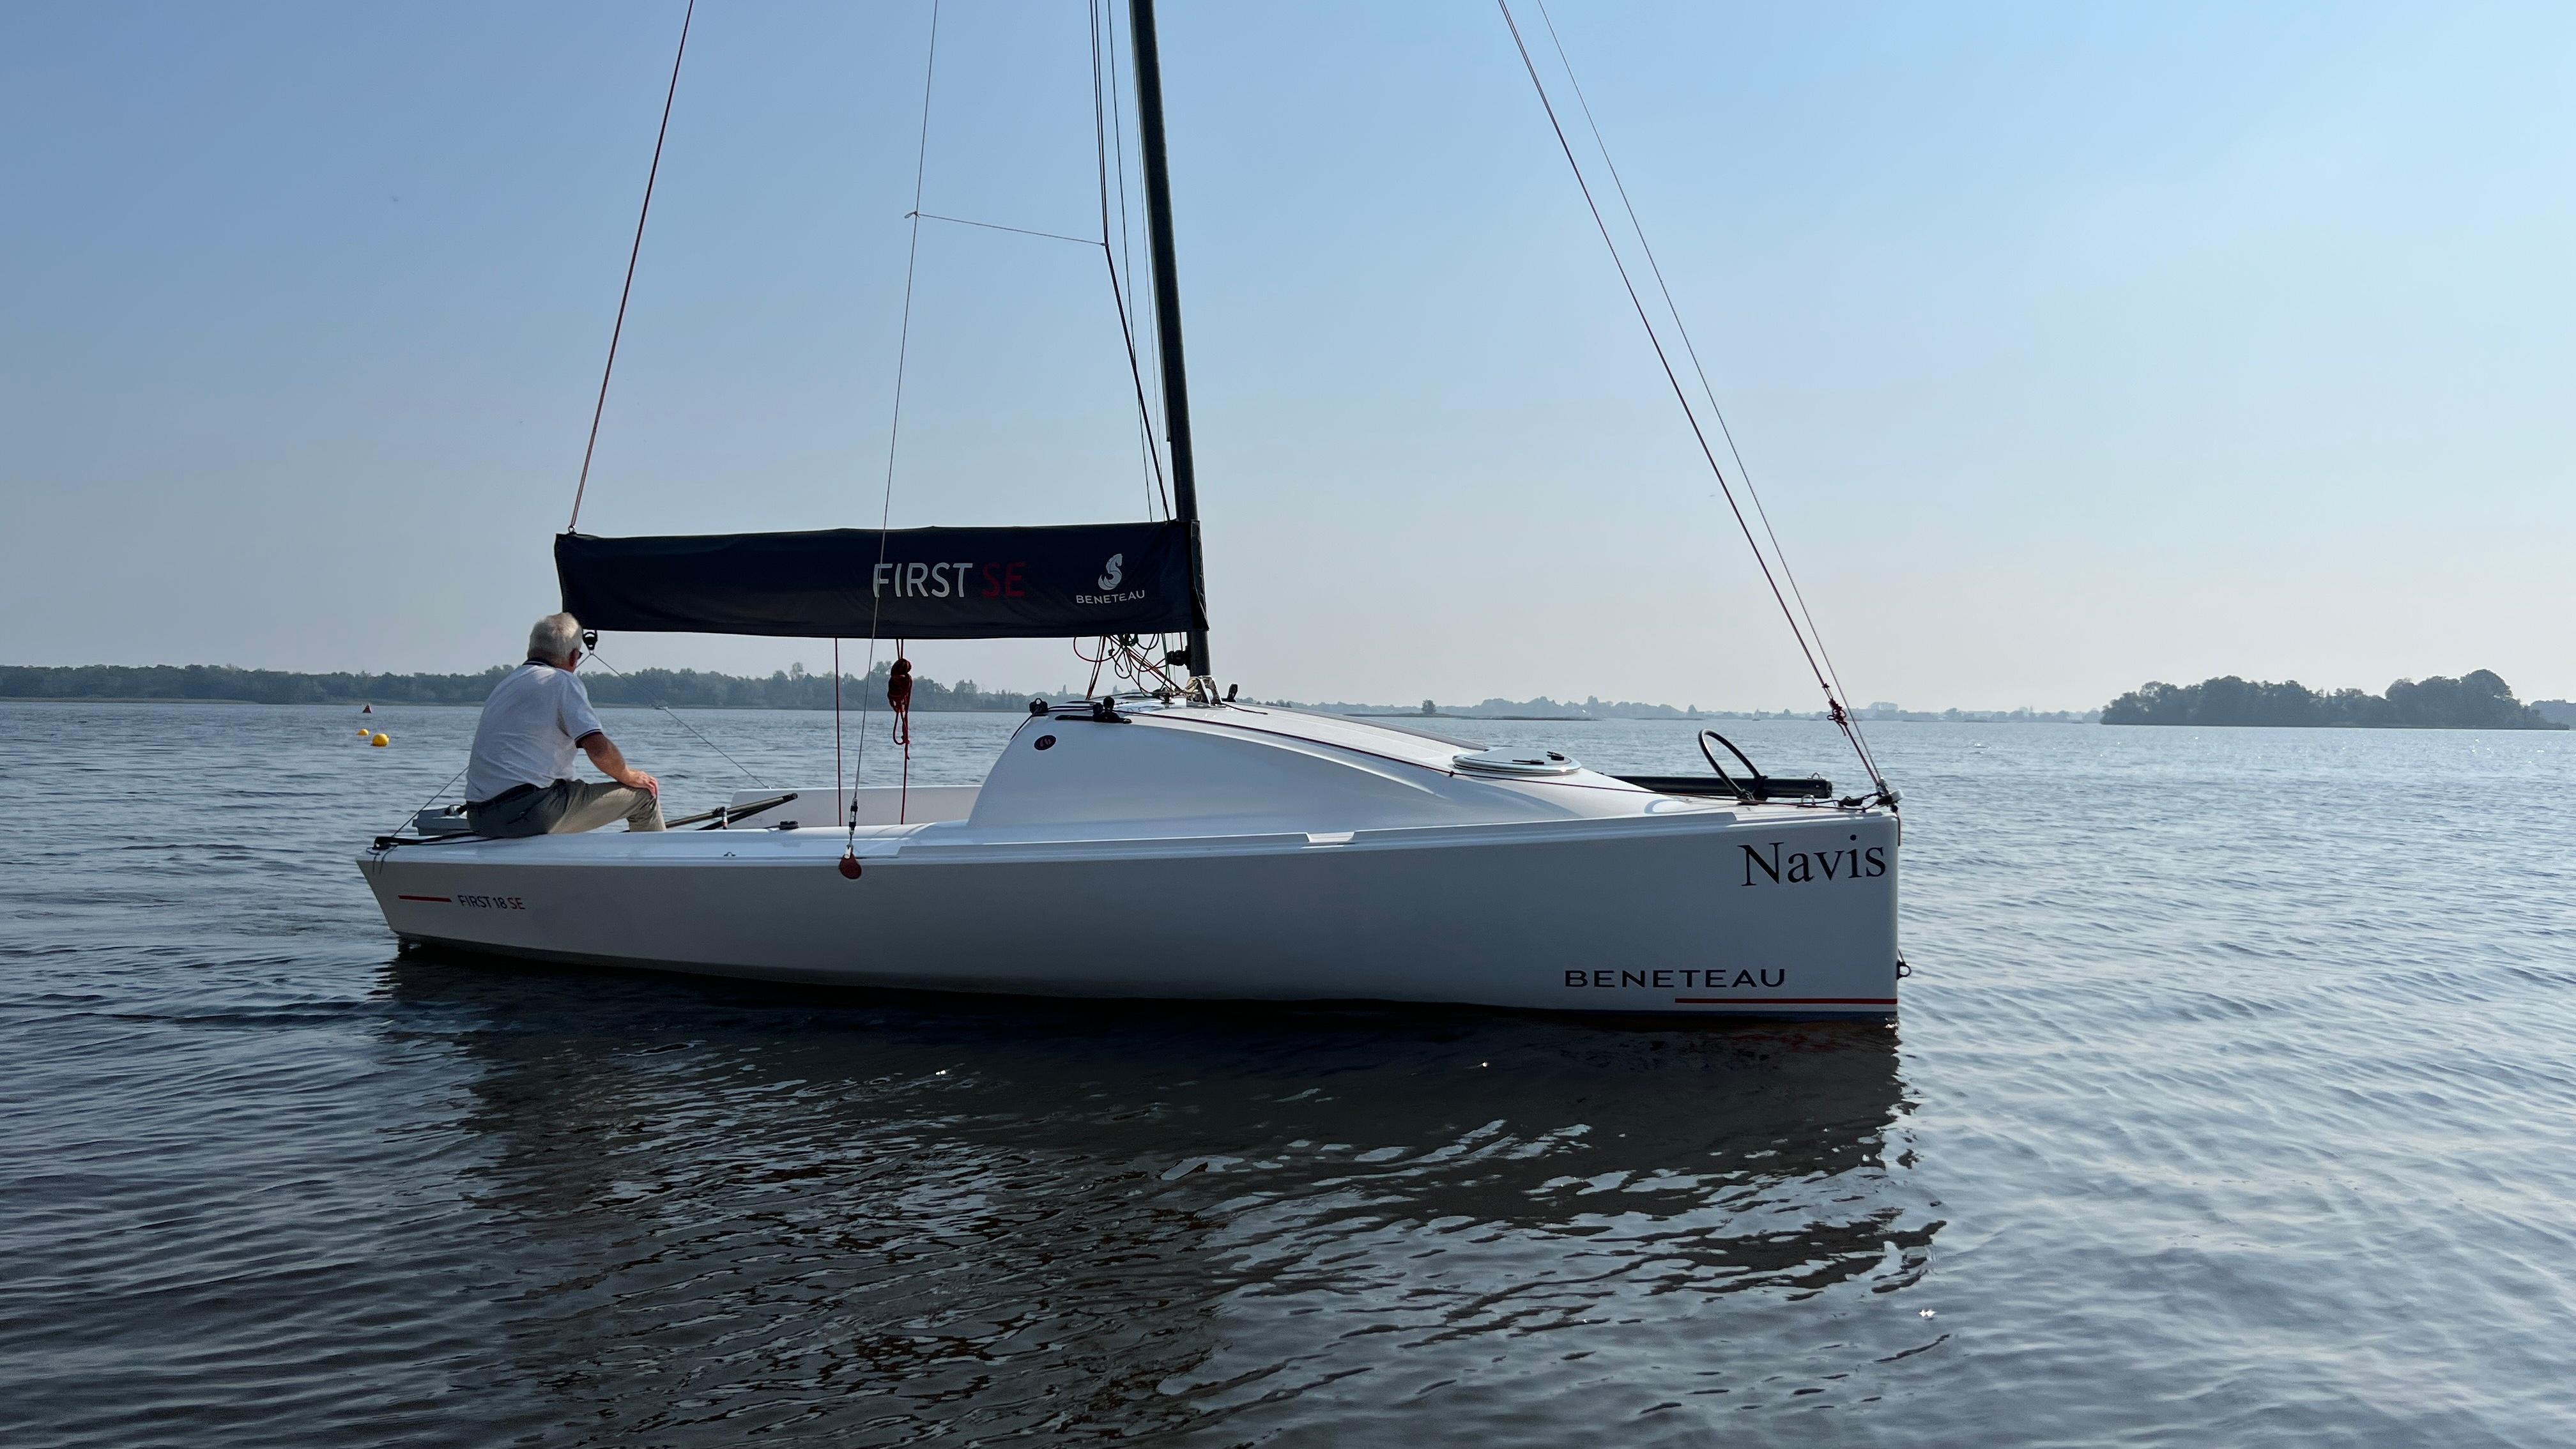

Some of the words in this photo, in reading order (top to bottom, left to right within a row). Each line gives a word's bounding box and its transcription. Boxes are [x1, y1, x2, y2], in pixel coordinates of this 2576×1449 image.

[873, 563, 973, 597] FIRST
[983, 563, 1025, 597] SE
[1076, 590, 1146, 604] BENETEAU
[1738, 834, 1887, 887] Navis
[457, 894, 492, 908] FIRST
[493, 897, 507, 909] 18
[508, 898, 525, 910] SE
[1565, 969, 1786, 988] BENETEAU
